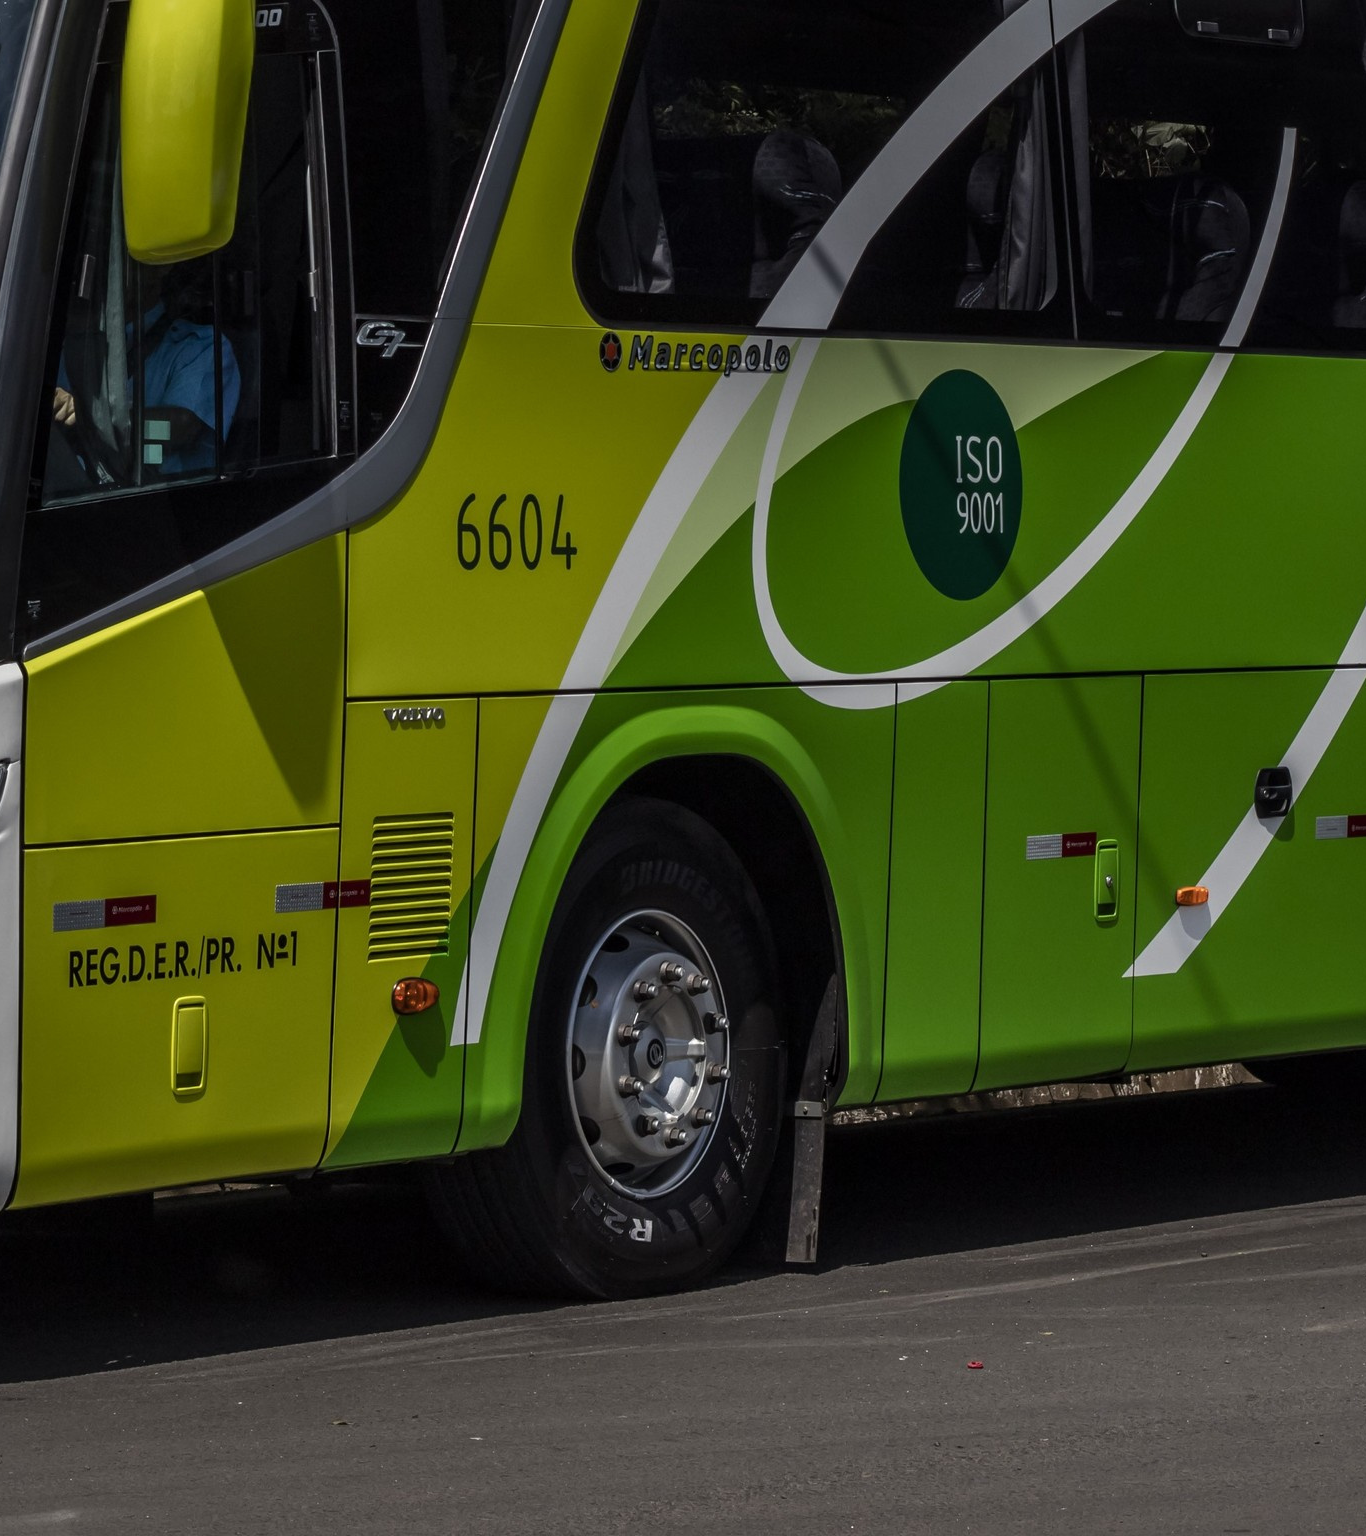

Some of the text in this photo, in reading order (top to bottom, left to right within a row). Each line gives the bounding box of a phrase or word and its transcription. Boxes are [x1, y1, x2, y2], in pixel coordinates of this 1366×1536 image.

[628, 335, 791, 378] Marcopolo
[955, 435, 1004, 485] ISO
[457, 493, 578, 571] 6604
[956, 491, 1004, 535] 9001
[69, 935, 242, 989] REG.D.E.R./PR.
